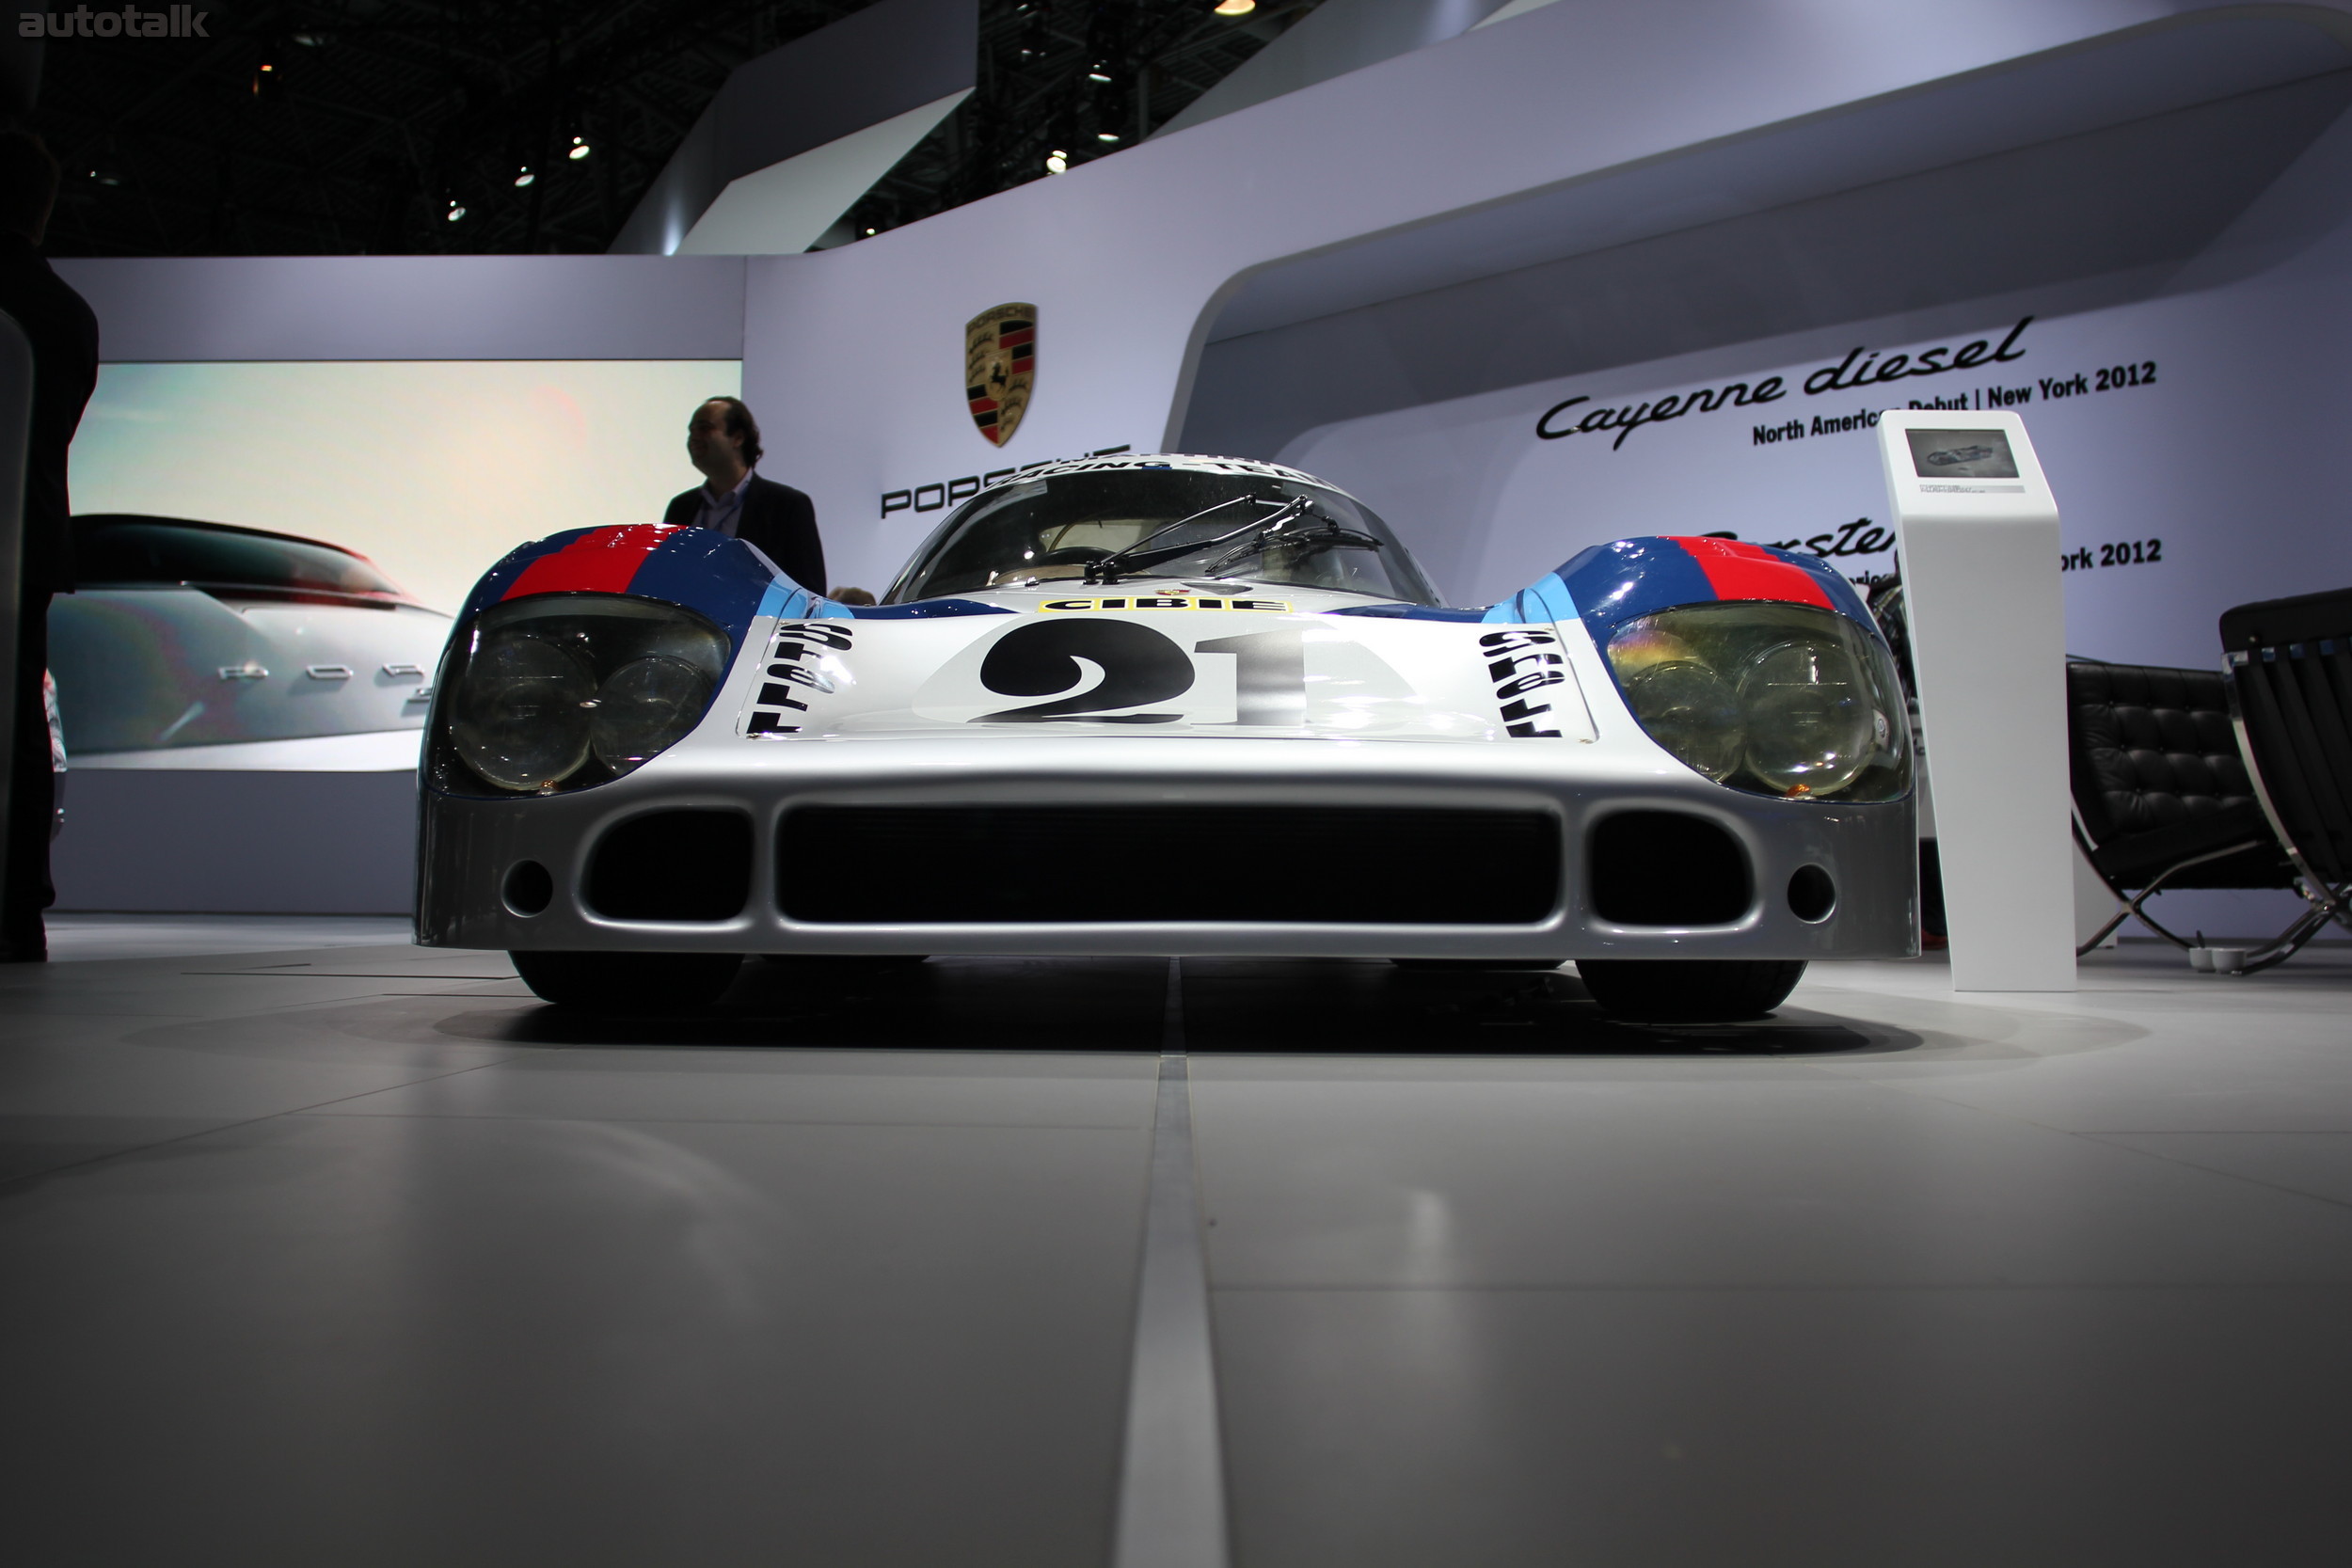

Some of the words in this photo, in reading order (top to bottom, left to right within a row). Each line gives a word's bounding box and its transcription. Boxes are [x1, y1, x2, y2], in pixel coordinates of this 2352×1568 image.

[1536, 376, 1787, 451] Cayenne
[1804, 315, 2034, 395] diesel
[1753, 420, 1804, 446] North
[1810, 407, 1900, 436] Americ
[1987, 386, 2032, 409] New
[2039, 373, 2089, 401] York
[2095, 361, 2156, 392] 2012
[2061, 546, 2093, 572] ork
[2101, 538, 2162, 567] 2012
[1043, 597, 1287, 611] CIBIE
[966, 618, 1309, 726] 21
